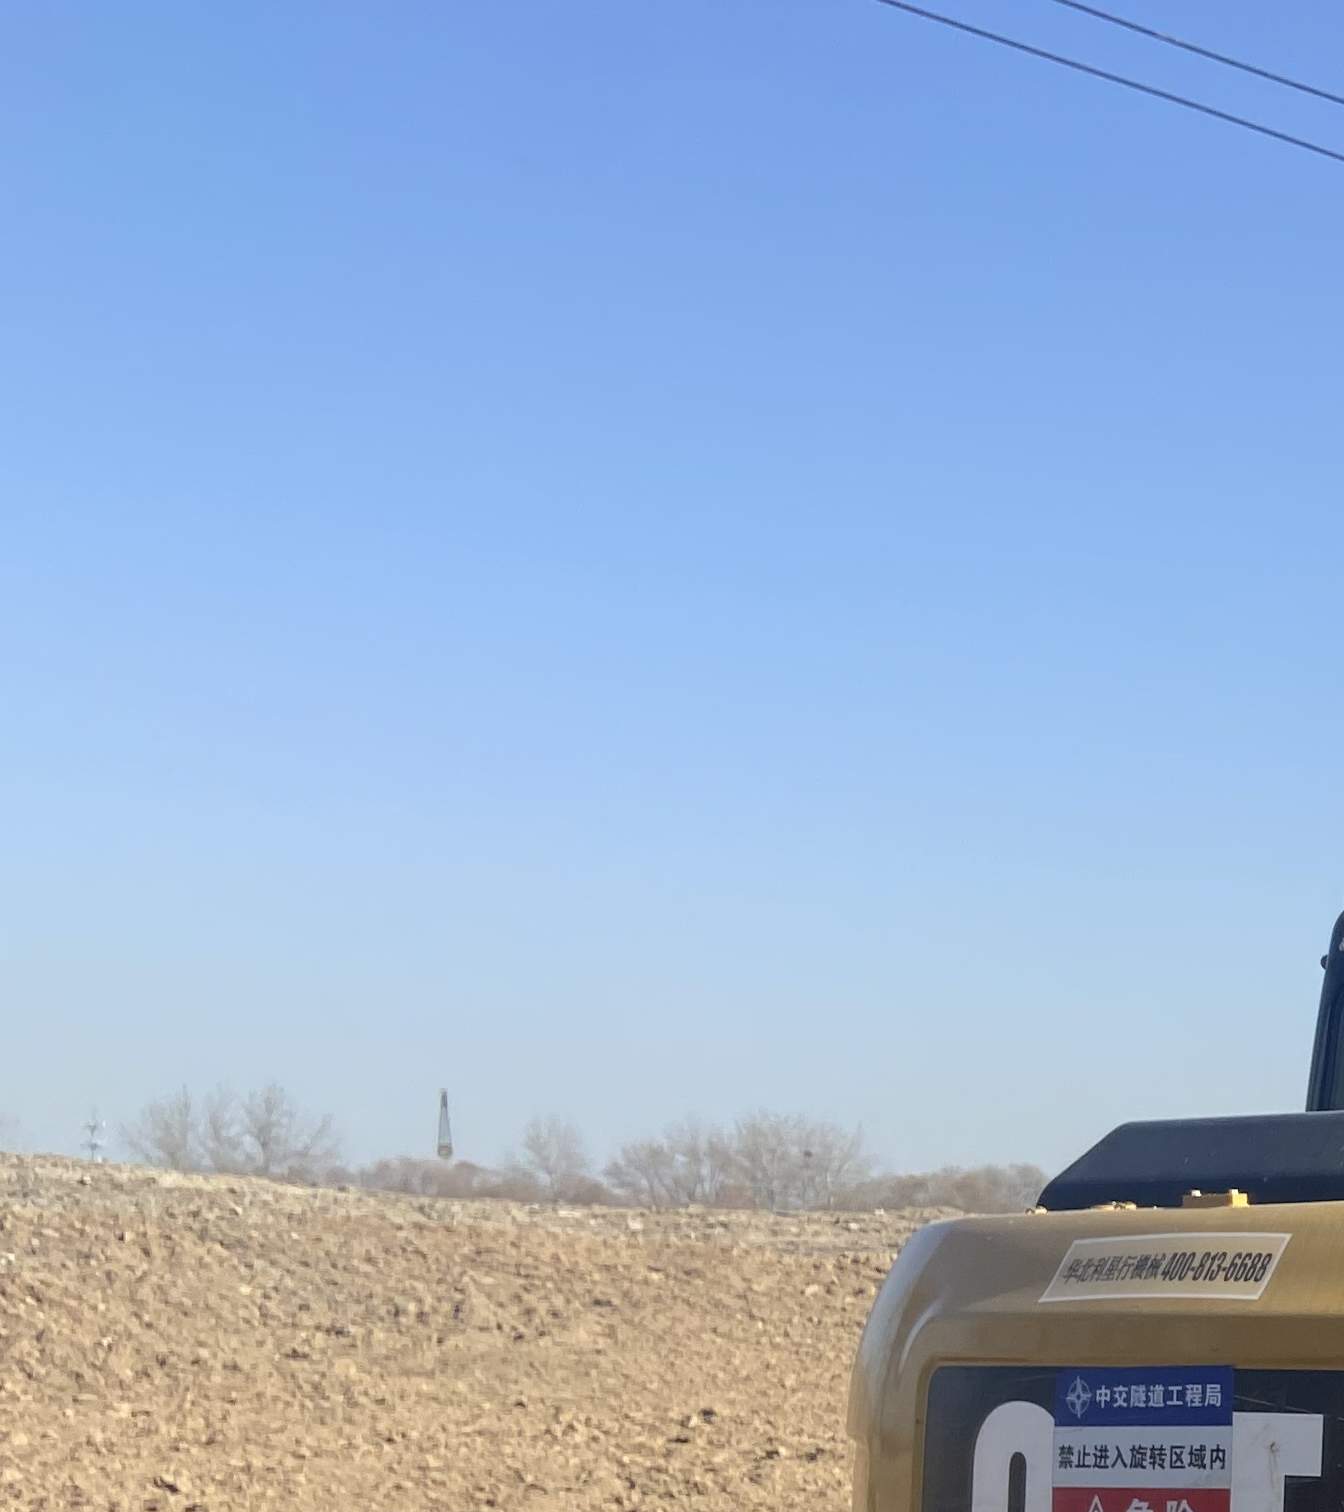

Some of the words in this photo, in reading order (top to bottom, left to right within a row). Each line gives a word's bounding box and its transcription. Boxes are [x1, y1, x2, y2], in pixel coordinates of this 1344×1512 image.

[1095, 1383, 1222, 1409] 中交隧道工程局
[1057, 1443, 1227, 1471] 禁止进入旋转区域内
